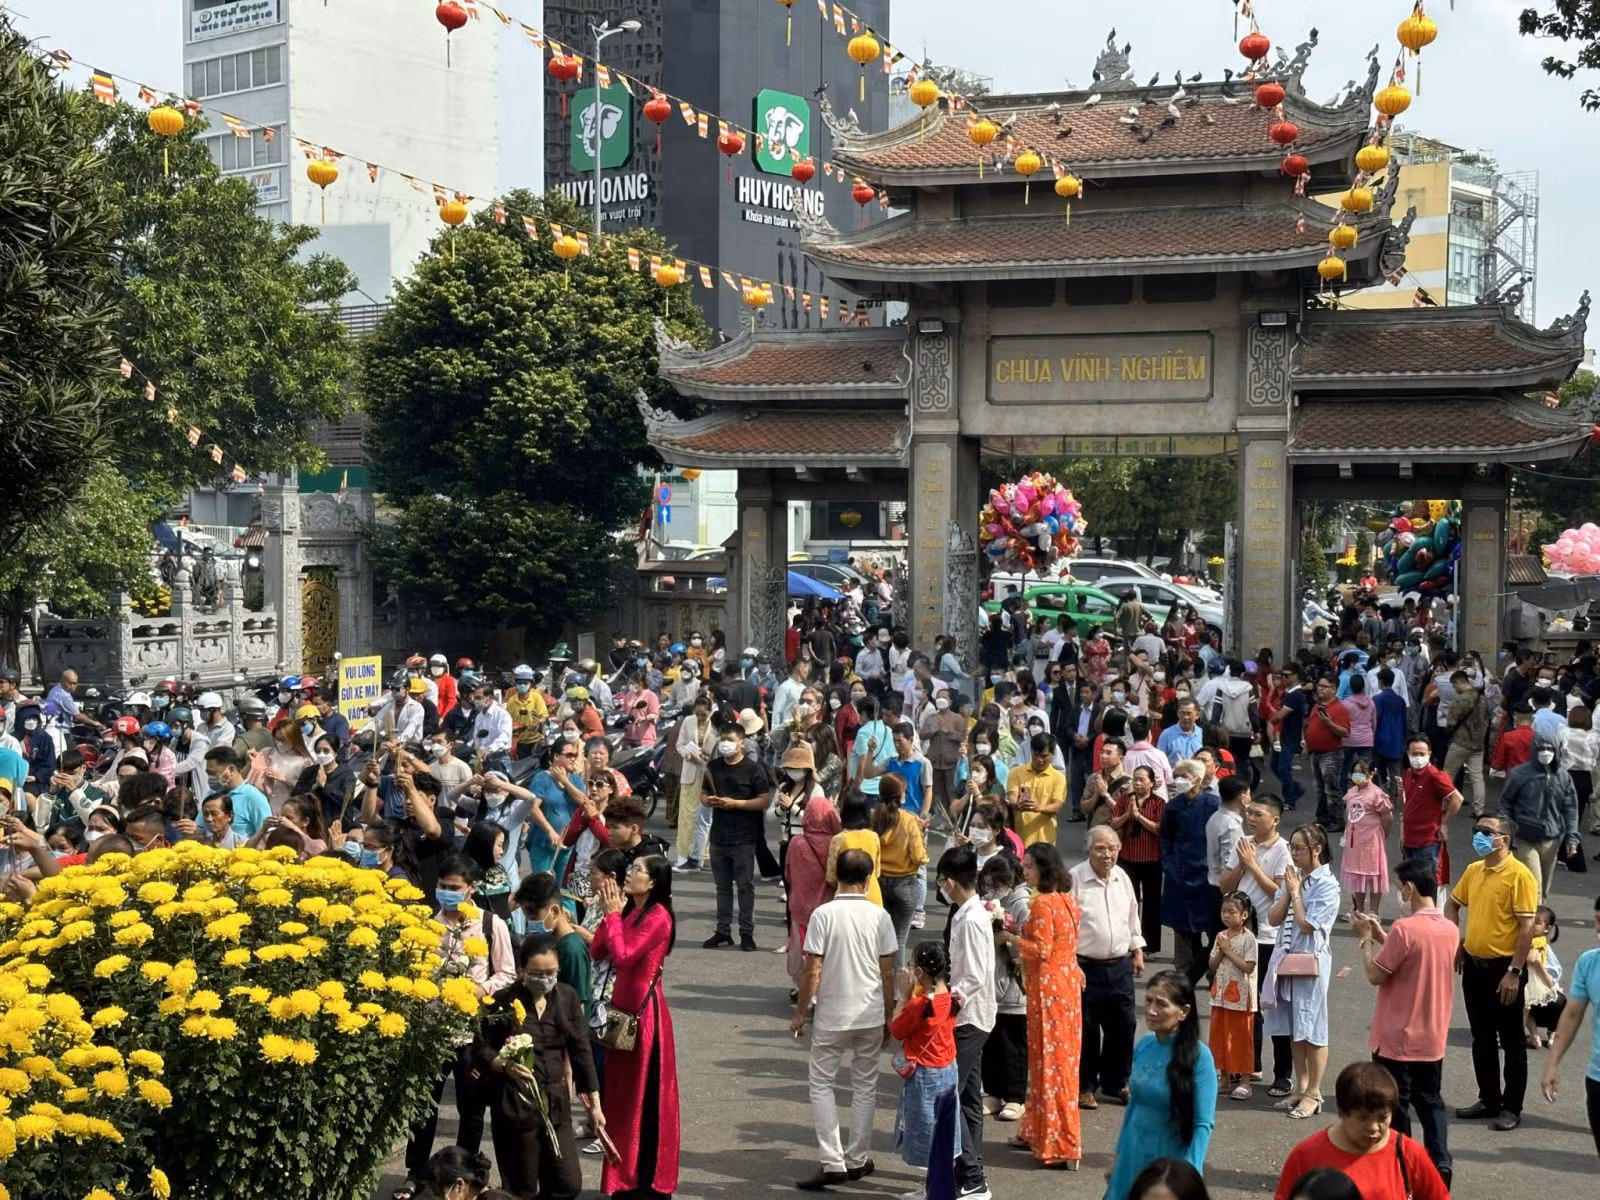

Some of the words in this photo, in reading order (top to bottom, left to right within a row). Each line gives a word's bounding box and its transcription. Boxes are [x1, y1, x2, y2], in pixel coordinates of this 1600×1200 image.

[995, 352, 1053, 384] CHÙA
[345, 666, 357, 679] VUI
[358, 662, 376, 679] LÒNG
[354, 686, 363, 699] XE
